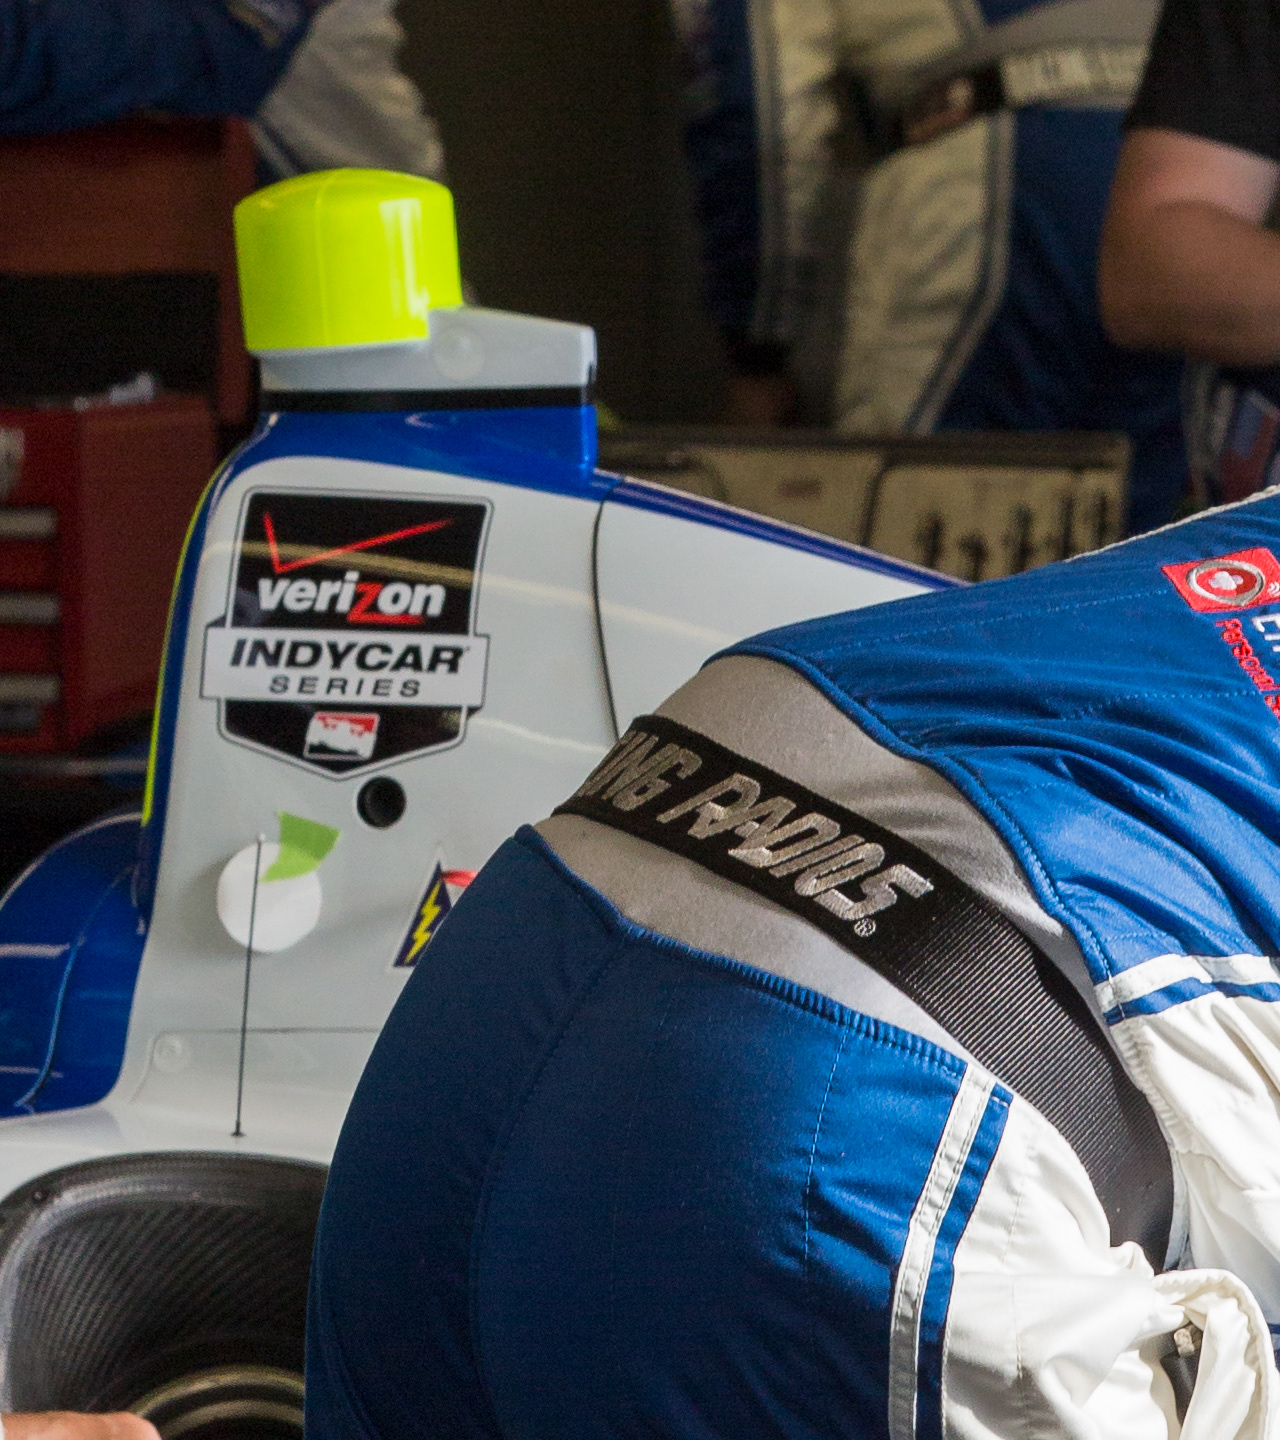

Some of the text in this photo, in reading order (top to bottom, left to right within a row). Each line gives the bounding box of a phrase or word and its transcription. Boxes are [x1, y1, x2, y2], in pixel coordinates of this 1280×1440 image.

[257, 569, 447, 626] verizon
[229, 637, 466, 675] INDYCAR
[268, 674, 422, 699] SERIES
